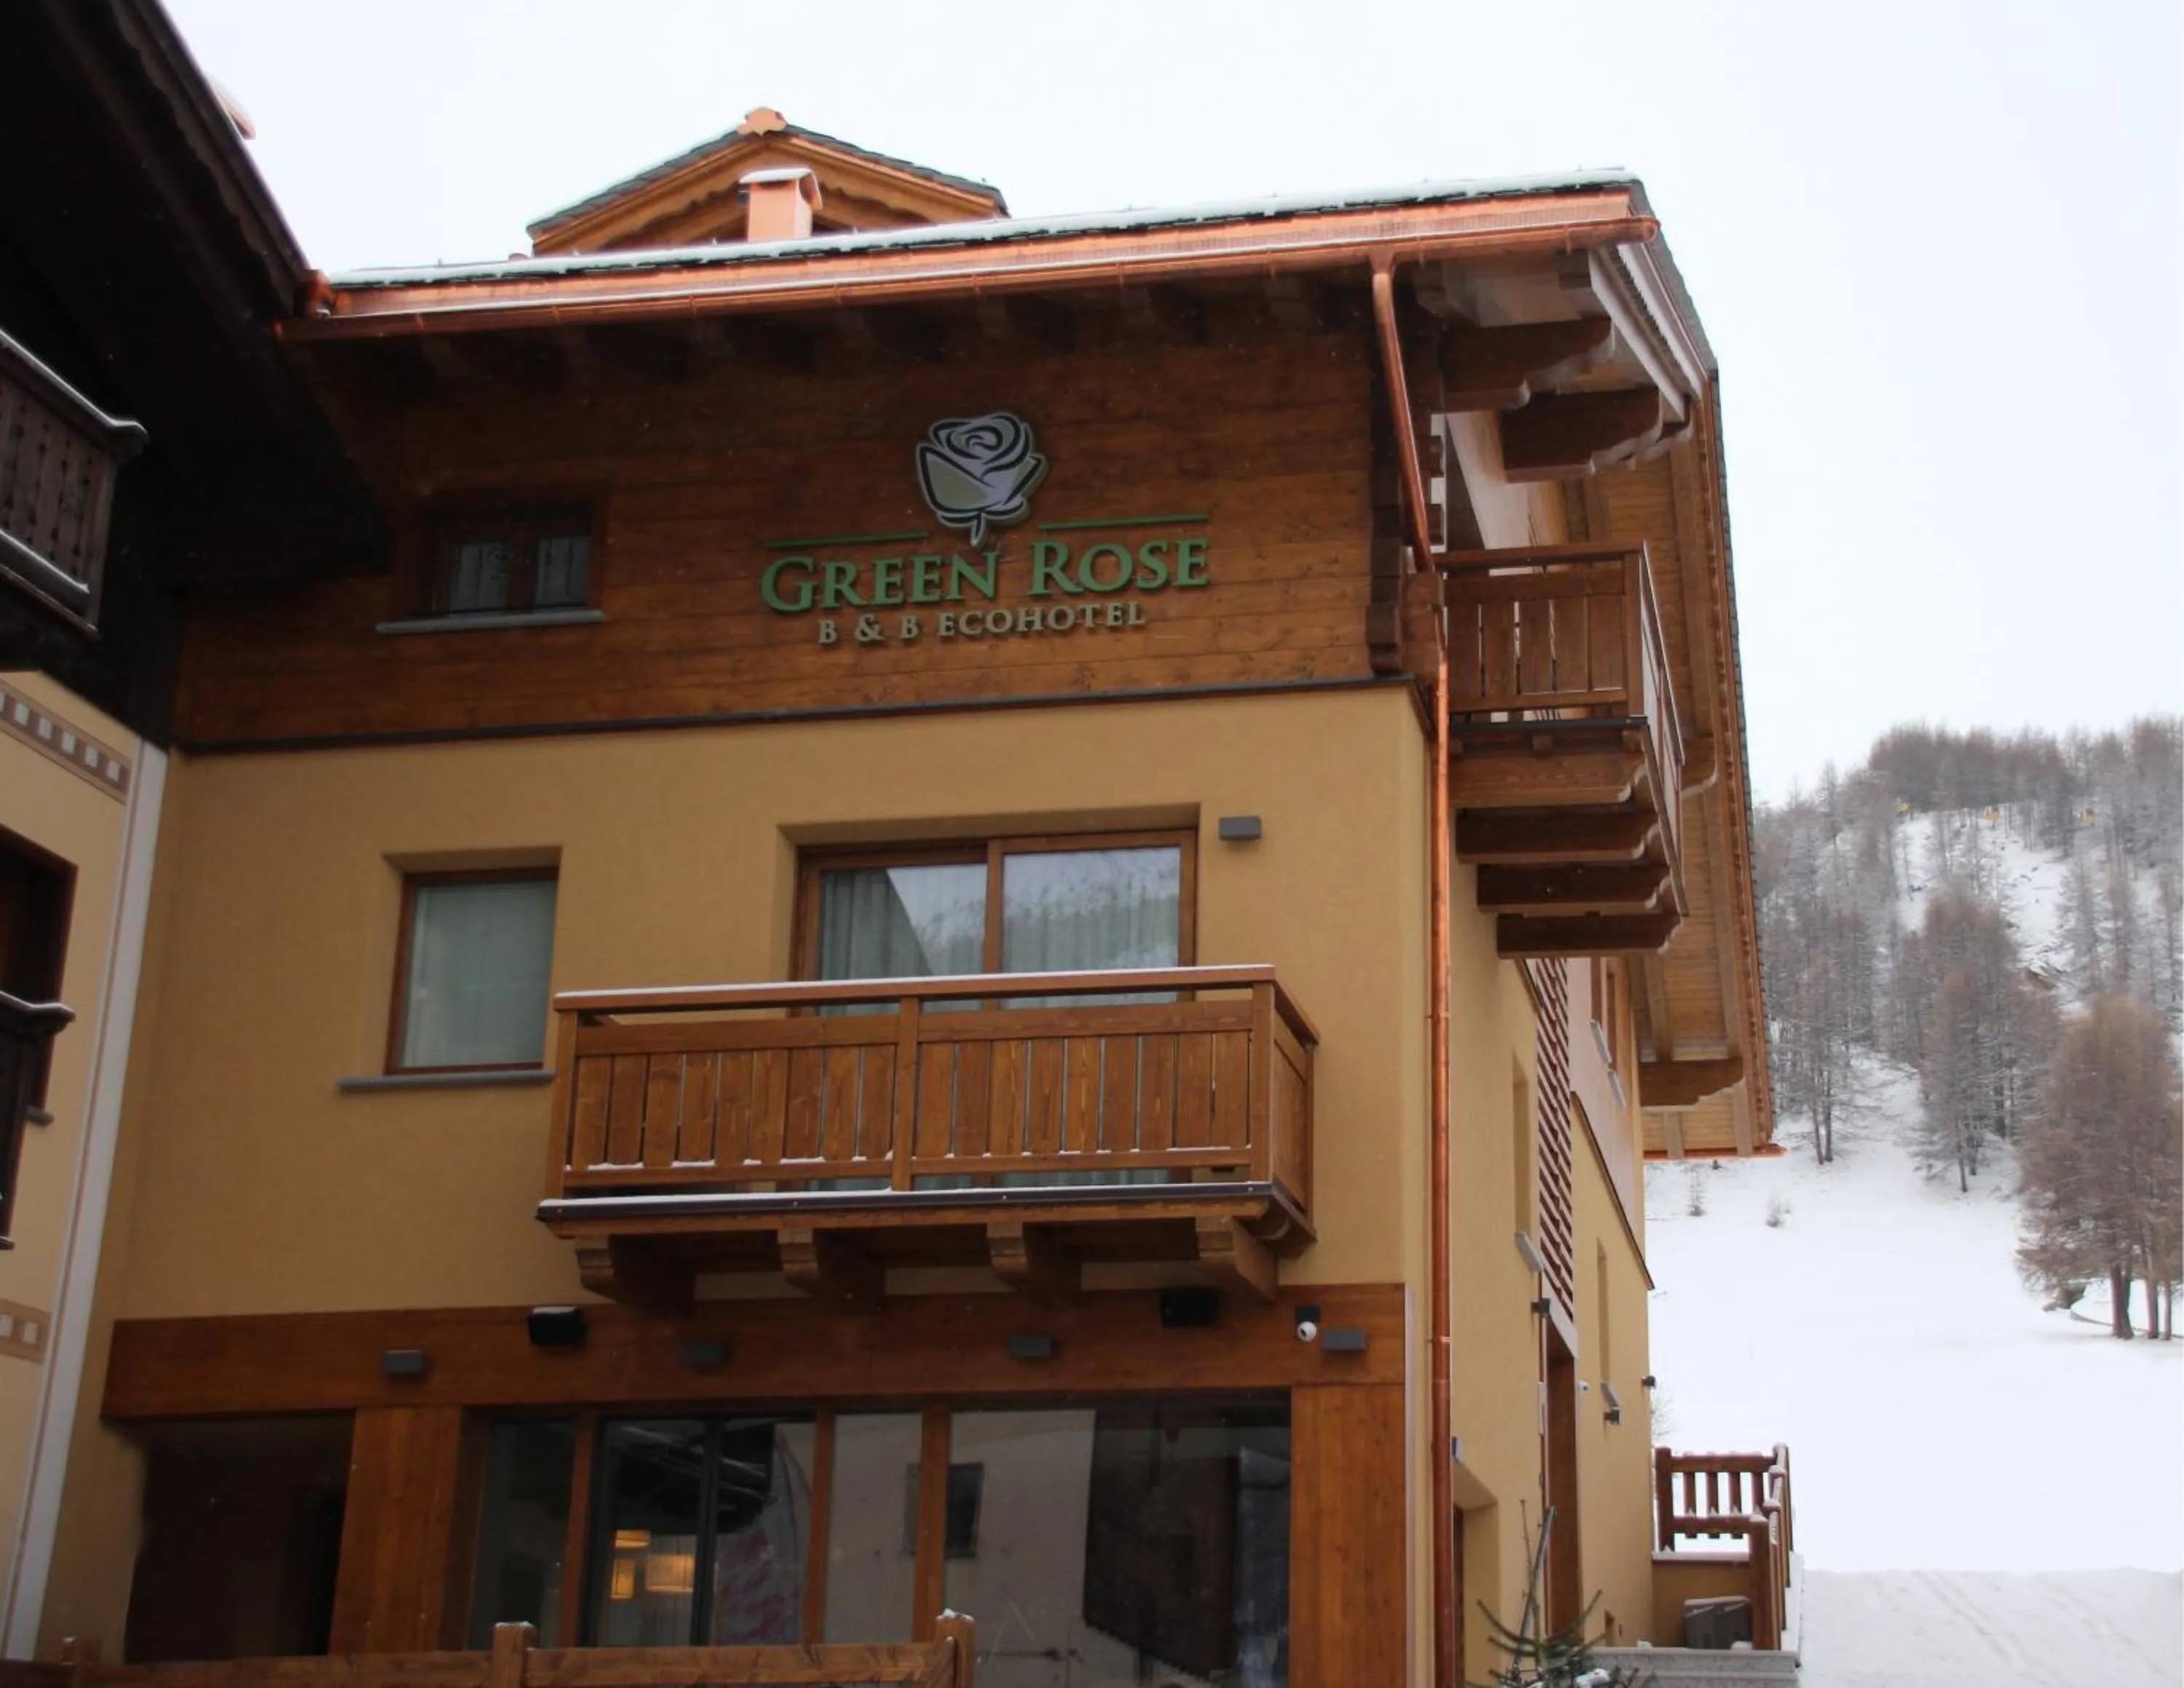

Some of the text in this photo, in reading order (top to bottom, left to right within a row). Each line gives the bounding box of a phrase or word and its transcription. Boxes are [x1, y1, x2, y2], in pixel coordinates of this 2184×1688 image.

[761, 537, 1209, 612] GREEN ROSE
[818, 602, 1145, 644] B & B ECOHOTEL
